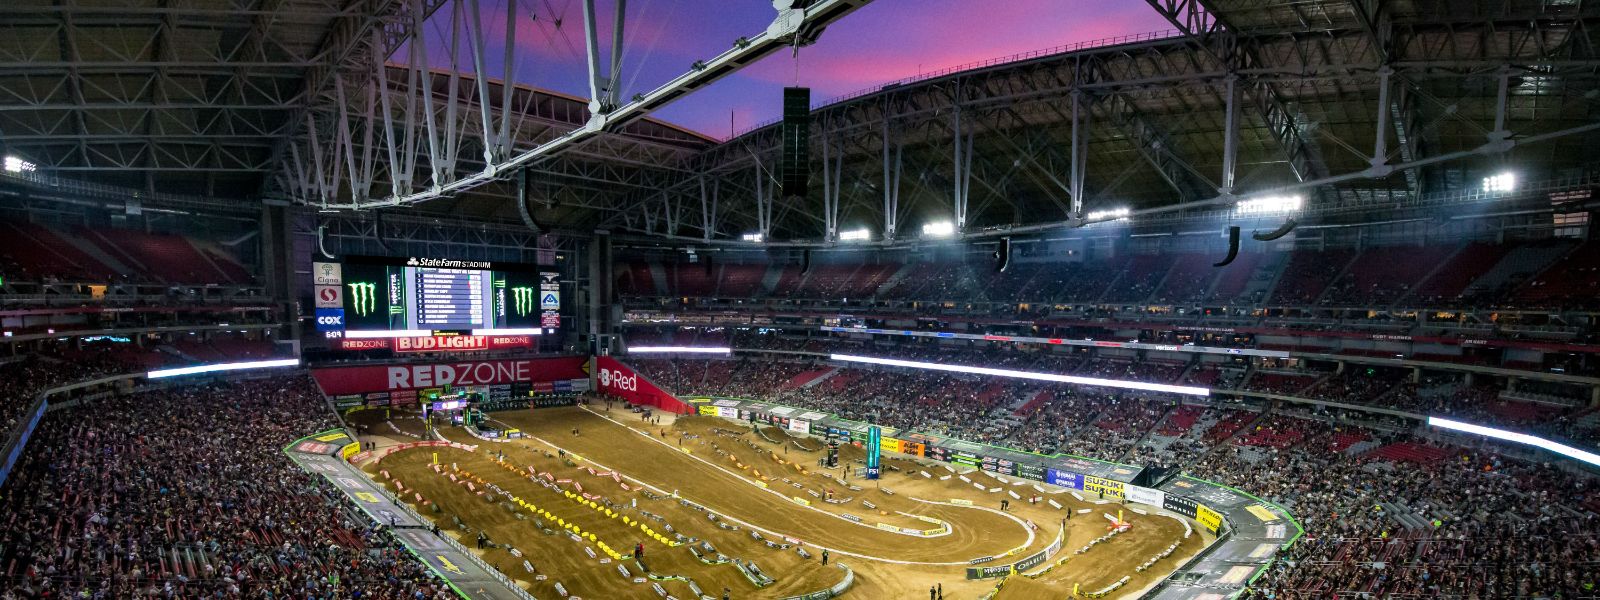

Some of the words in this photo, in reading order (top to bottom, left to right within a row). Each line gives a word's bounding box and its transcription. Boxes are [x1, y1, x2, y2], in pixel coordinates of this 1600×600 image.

[461, 261, 491, 269] STADIUM
[317, 276, 339, 285] Cigna
[399, 336, 436, 349] BUD
[438, 335, 485, 348] LIGHT
[388, 361, 531, 389] REDZONE
[1085, 477, 1123, 490] SUZUKI
[1085, 484, 1123, 497] SUUKI
